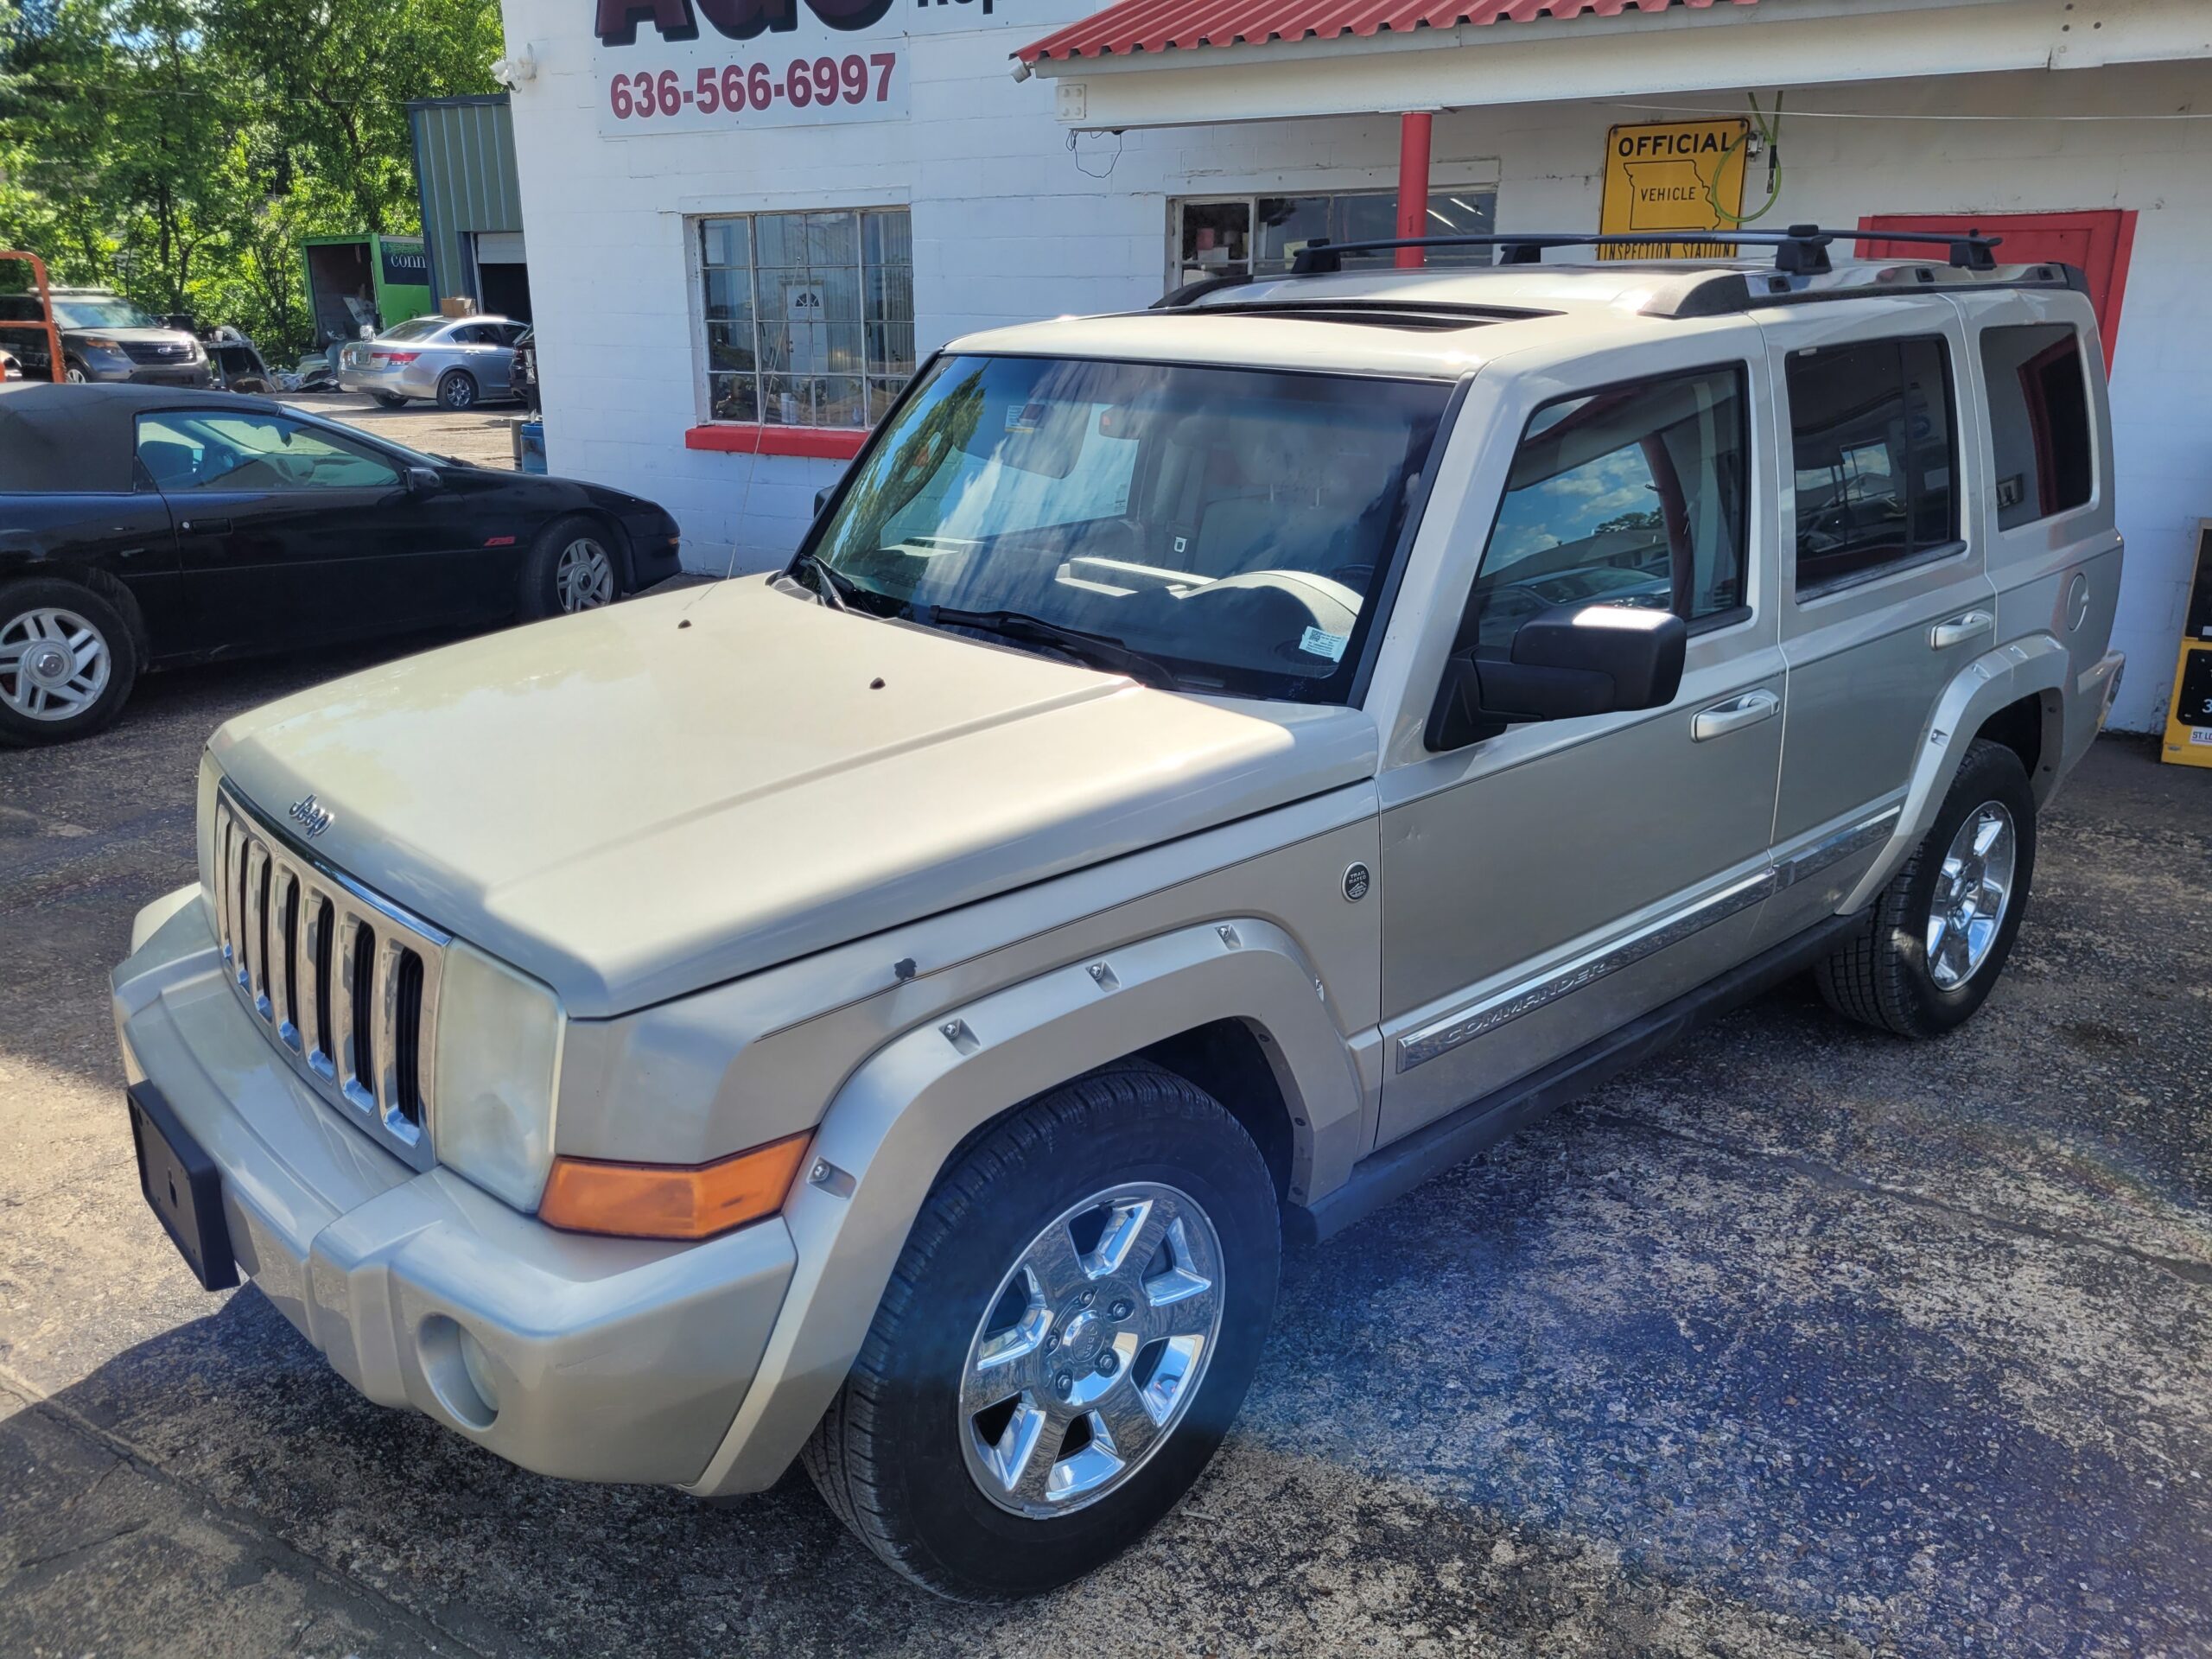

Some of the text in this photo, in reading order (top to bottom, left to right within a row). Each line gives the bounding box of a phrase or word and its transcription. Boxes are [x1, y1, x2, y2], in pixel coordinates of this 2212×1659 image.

[610, 52, 897, 120] 636-566-6997
[1618, 131, 1735, 157] OFFICIAL
[1641, 186, 1696, 202] VEHICLE
[289, 793, 335, 838] Jeep
[1444, 963, 1606, 1045] COMMANDER
